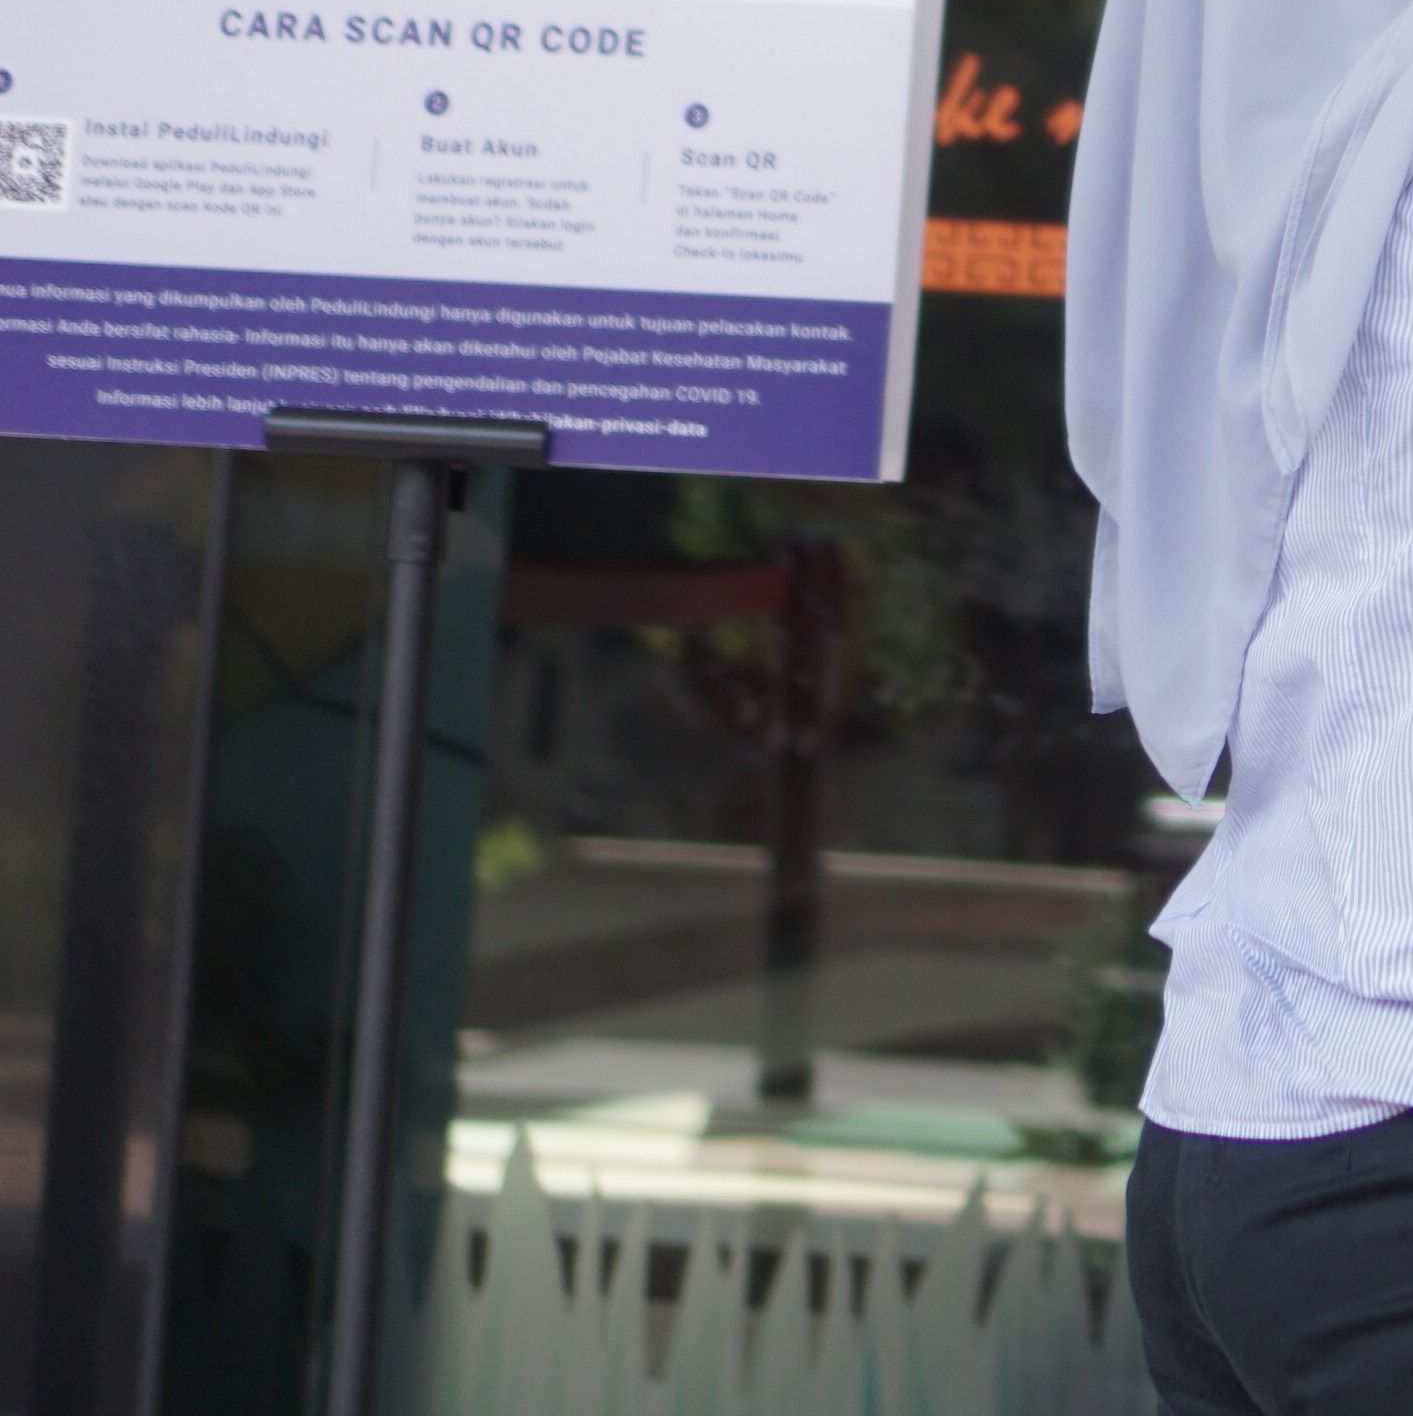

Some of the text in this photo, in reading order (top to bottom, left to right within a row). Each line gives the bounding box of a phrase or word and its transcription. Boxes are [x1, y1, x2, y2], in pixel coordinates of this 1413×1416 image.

[219, 9, 645, 57] CARA SCAN QR CODE
[83, 119, 329, 151] Instal PeduliLindungi
[419, 134, 539, 158] Buat Akun
[680, 147, 778, 172] Scan QR
